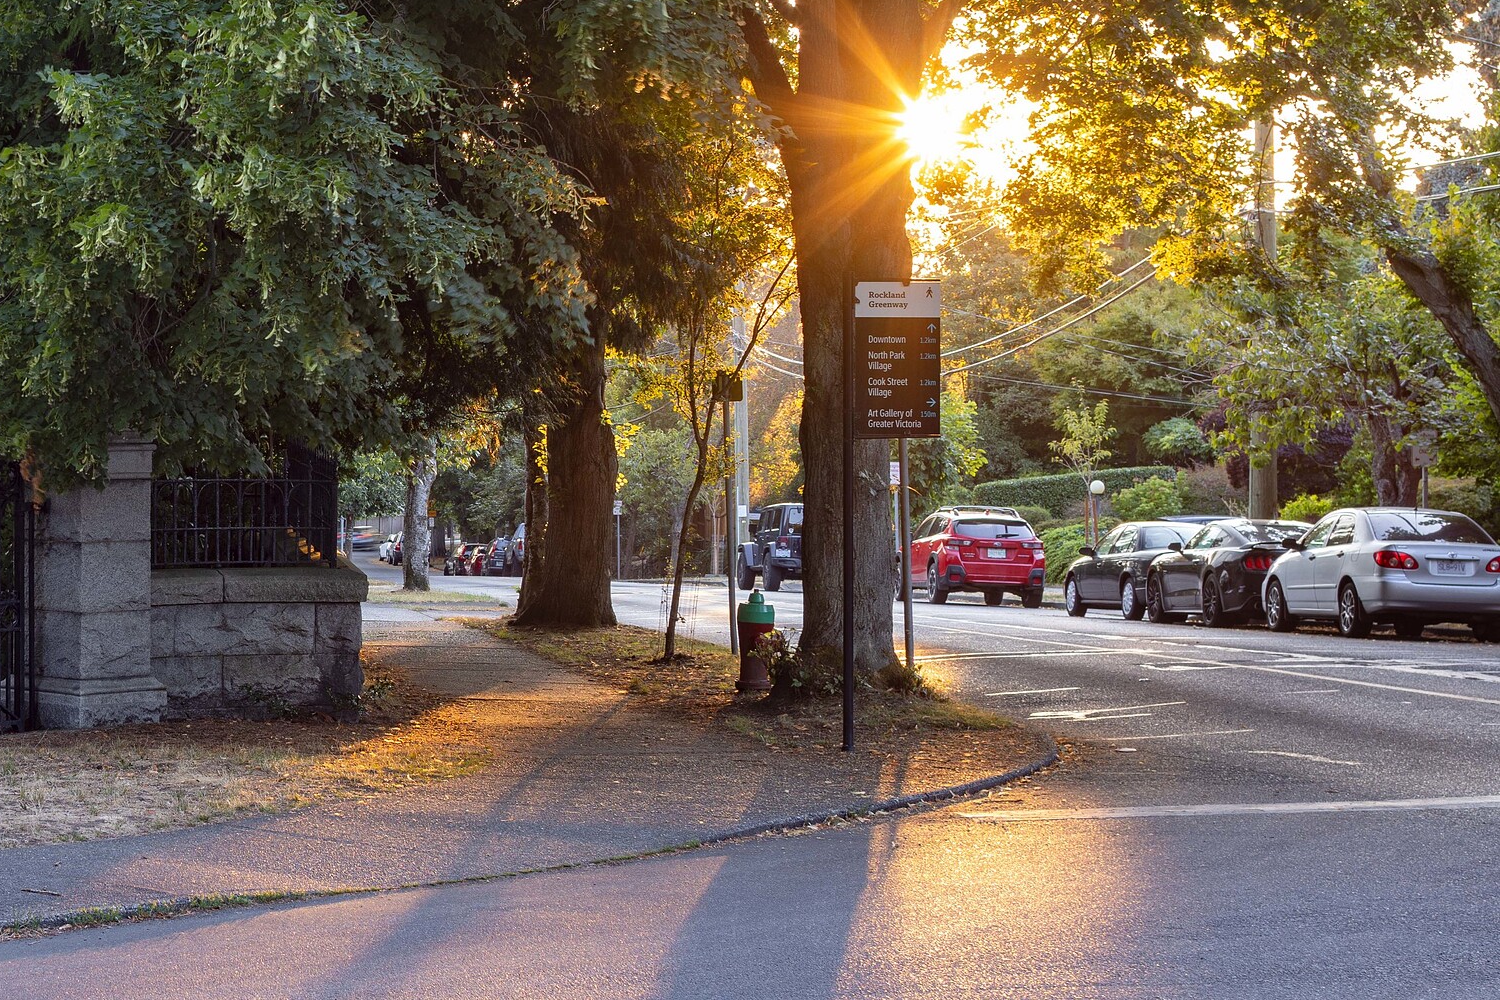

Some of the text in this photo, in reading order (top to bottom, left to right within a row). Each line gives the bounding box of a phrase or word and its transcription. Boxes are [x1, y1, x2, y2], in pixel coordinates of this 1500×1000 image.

[868, 291, 906, 299] Rockland
[868, 301, 908, 309] Greenway
[868, 335, 906, 344] Downtown
[868, 351, 905, 360] North Park
[868, 362, 892, 372] Village
[868, 377, 908, 386] Cook Street
[868, 388, 892, 398] Village
[868, 409, 913, 419] Art Gallery of
[868, 420, 921, 428] Greater Victoria
